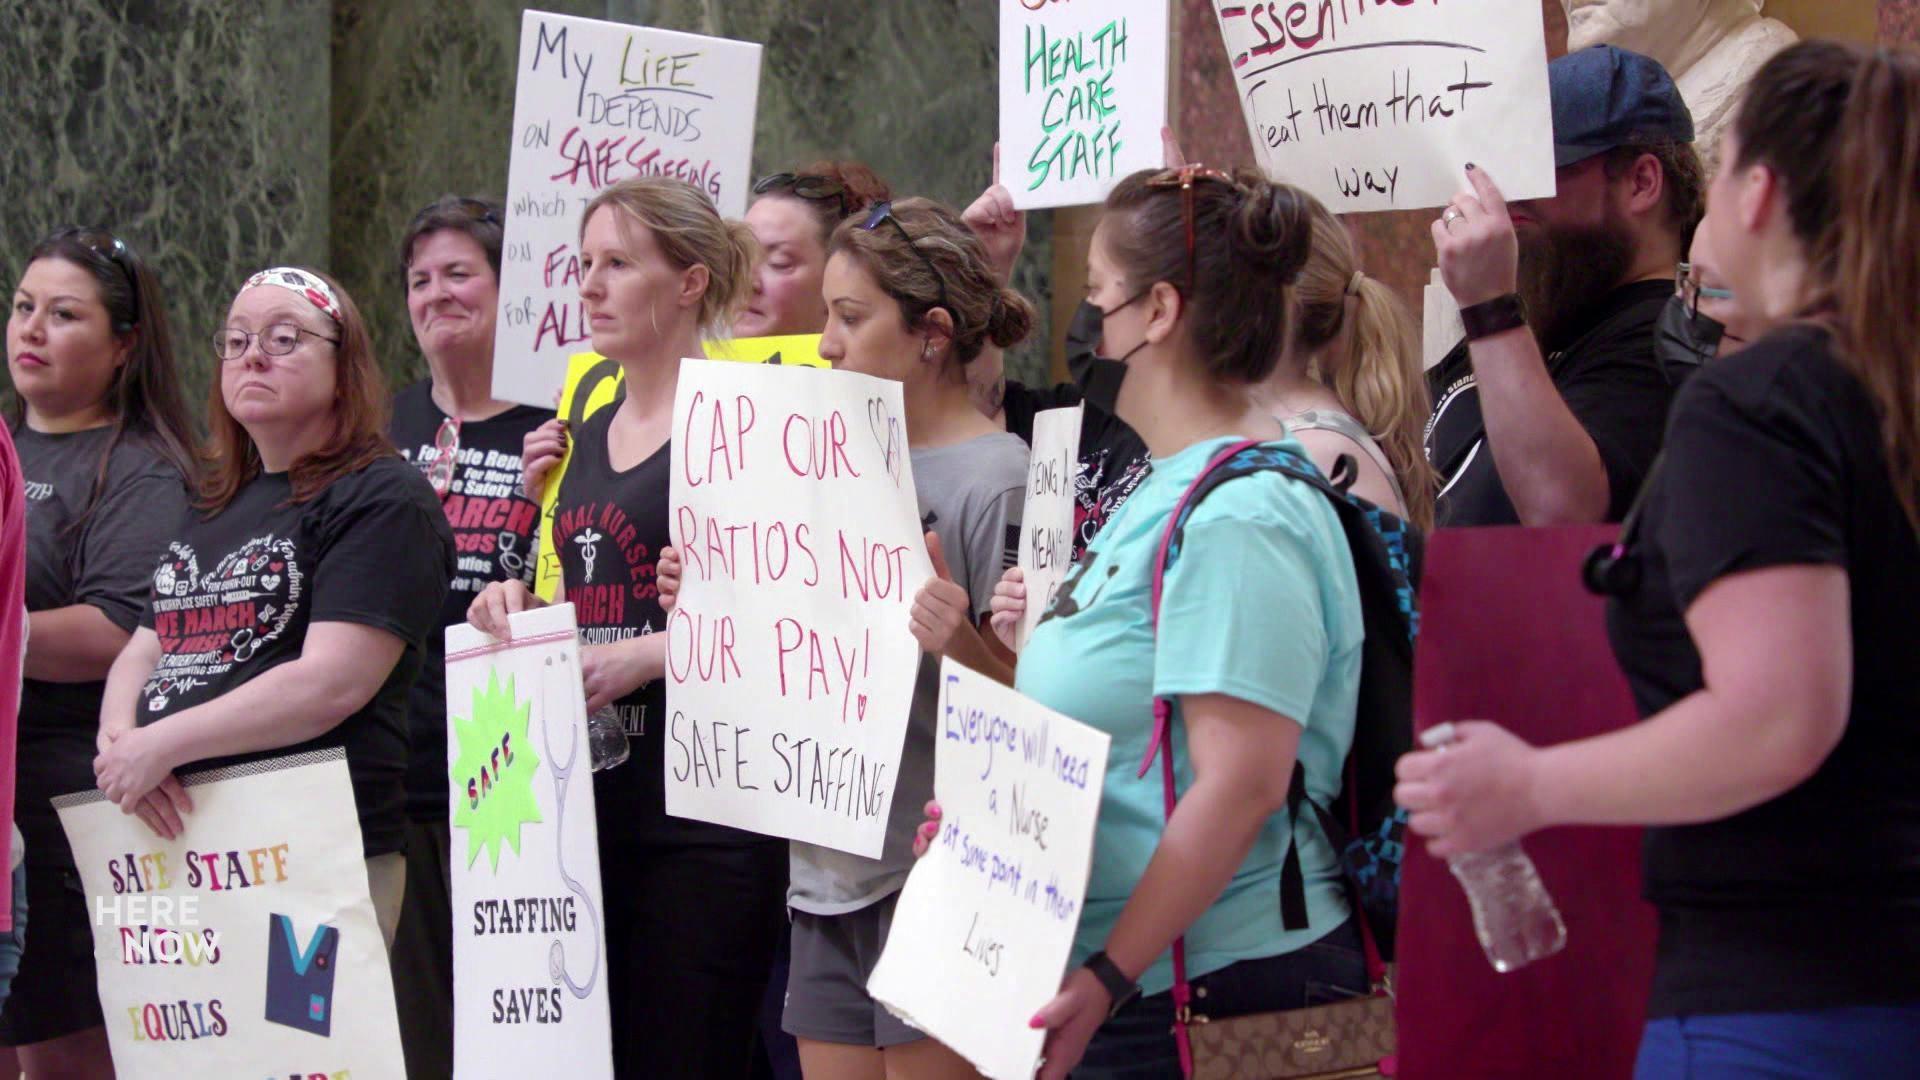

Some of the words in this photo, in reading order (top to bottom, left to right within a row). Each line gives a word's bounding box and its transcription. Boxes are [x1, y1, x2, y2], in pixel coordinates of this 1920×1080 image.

[533, 21, 593, 117] My
[1023, 16, 1128, 94] HEALTH
[588, 92, 702, 142] DEPENDS
[1041, 71, 1117, 133] CARE
[1313, 78, 1378, 136] them
[1386, 61, 1494, 124] that
[523, 120, 551, 149] ON
[550, 127, 627, 190] SAFE
[1027, 120, 1122, 191] STAFF
[1334, 164, 1398, 204] way
[514, 192, 566, 217] which
[507, 242, 532, 262] ON
[504, 297, 537, 328] FOR
[684, 390, 756, 487] CAP
[782, 410, 861, 482] OUR
[444, 494, 537, 537] ARCH
[464, 479, 513, 498] Safety
[599, 502, 657, 599] NURSES
[677, 505, 819, 587] RATIOS
[838, 529, 911, 604] NOT
[183, 601, 256, 636] MARCH
[667, 607, 741, 684] OUR
[774, 617, 871, 723] PAY!
[945, 674, 1018, 781] Everyone
[1022, 718, 1047, 764] will
[1053, 745, 1090, 789] need
[467, 732, 515, 812] SAFE
[671, 710, 759, 793] SAFE
[772, 732, 886, 822] STAFFING
[988, 788, 997, 815] a
[1009, 782, 1049, 851] Nurse
[108, 851, 171, 895] SAFE
[186, 843, 289, 892] STAFF
[943, 815, 960, 851] at
[987, 854, 1022, 896] point
[1024, 879, 1037, 904] in
[473, 896, 577, 937] STAFFING
[962, 912, 1004, 976] Lives
[128, 999, 228, 1042] EQUALS
[492, 987, 563, 1025] SAVES
